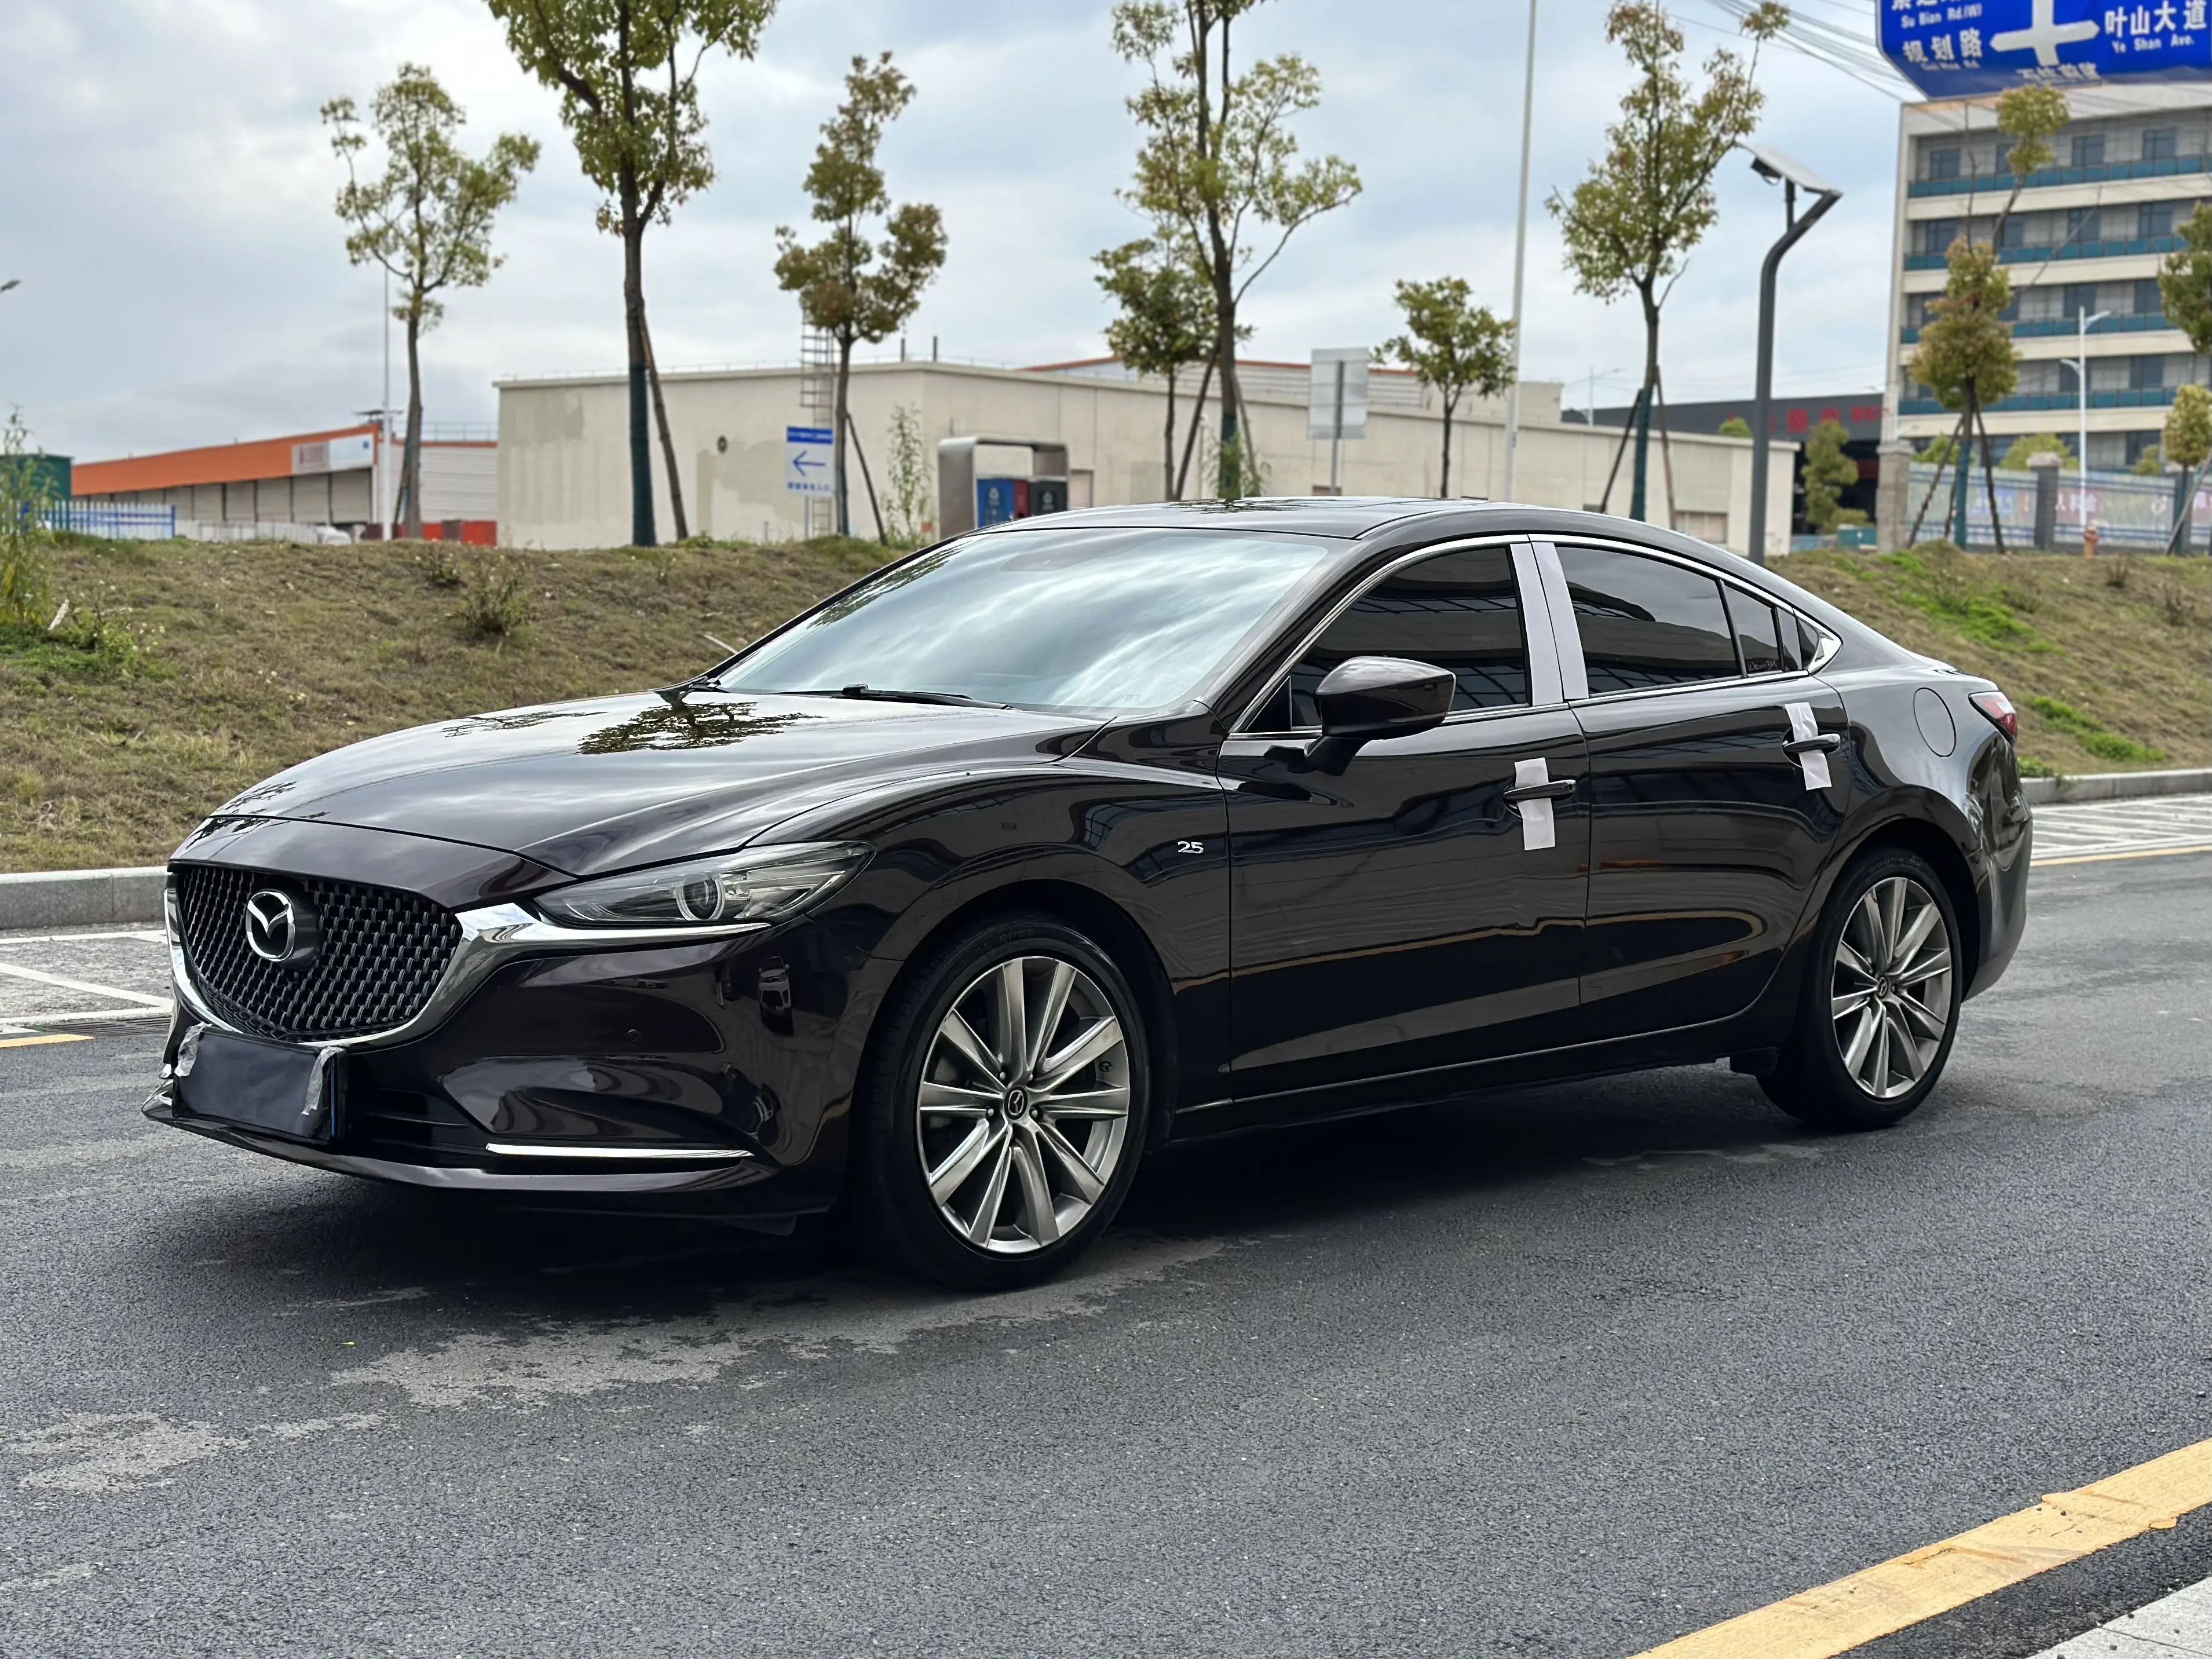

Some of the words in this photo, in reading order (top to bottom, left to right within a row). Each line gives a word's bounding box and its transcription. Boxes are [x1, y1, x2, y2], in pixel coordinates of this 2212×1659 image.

[2105, 0, 2207, 38] 叶山大道
[1903, 27, 1982, 62] 规划路
[2111, 40, 2126, 54] Ye
[2134, 37, 2162, 52] Shan
[2170, 33, 2195, 47] Ave.
[1178, 841, 1204, 854] 25
